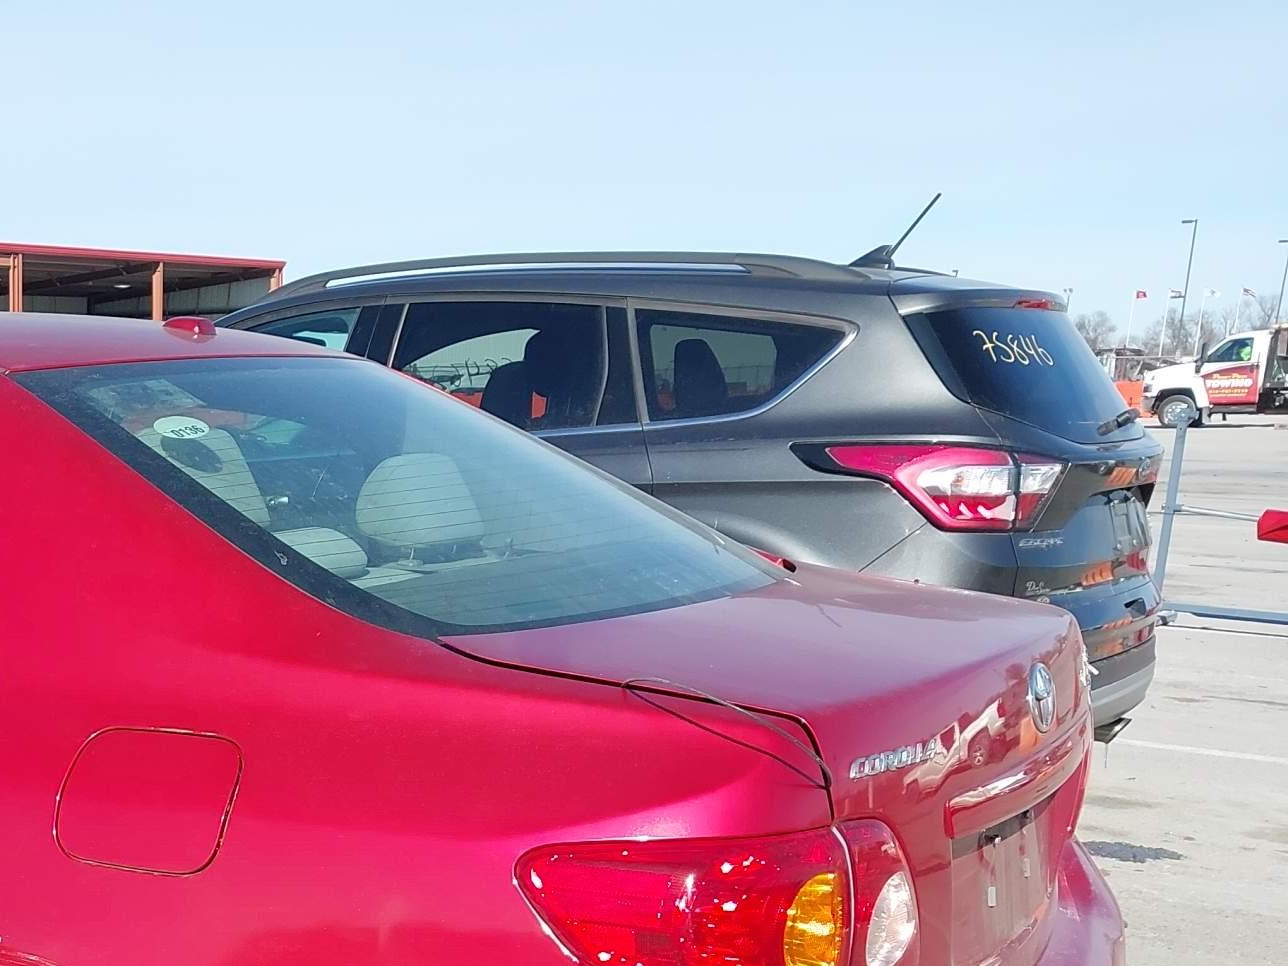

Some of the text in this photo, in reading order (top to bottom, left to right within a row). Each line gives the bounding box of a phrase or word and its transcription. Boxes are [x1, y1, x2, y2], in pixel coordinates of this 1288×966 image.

[972, 330, 1054, 366] 75846
[1205, 379, 1253, 388] TOWING
[171, 425, 205, 437] 0136
[850, 738, 936, 779] COROLLA
